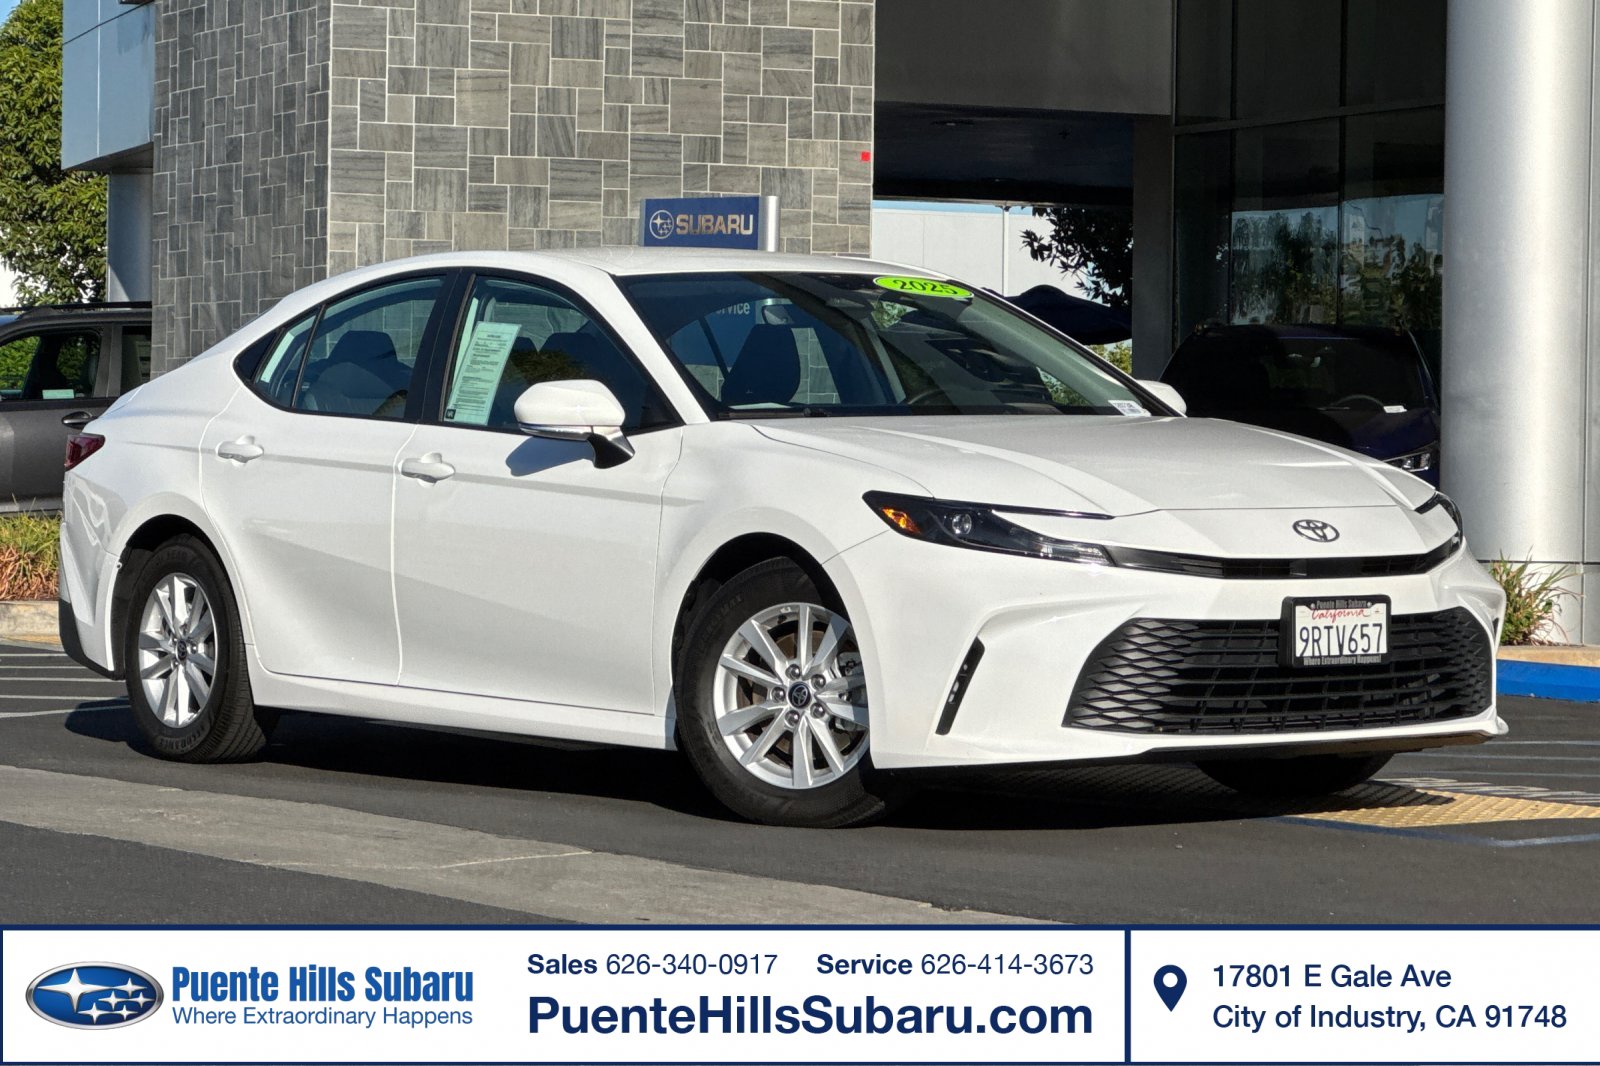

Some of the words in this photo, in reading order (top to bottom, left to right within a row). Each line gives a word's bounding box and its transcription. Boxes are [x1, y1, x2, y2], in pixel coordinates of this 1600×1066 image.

[676, 214, 754, 235] SUBARU
[893, 279, 958, 295] 2025
[715, 302, 751, 316] rvice
[1311, 608, 1371, 623] California
[1299, 623, 1383, 657] 9RTV657
